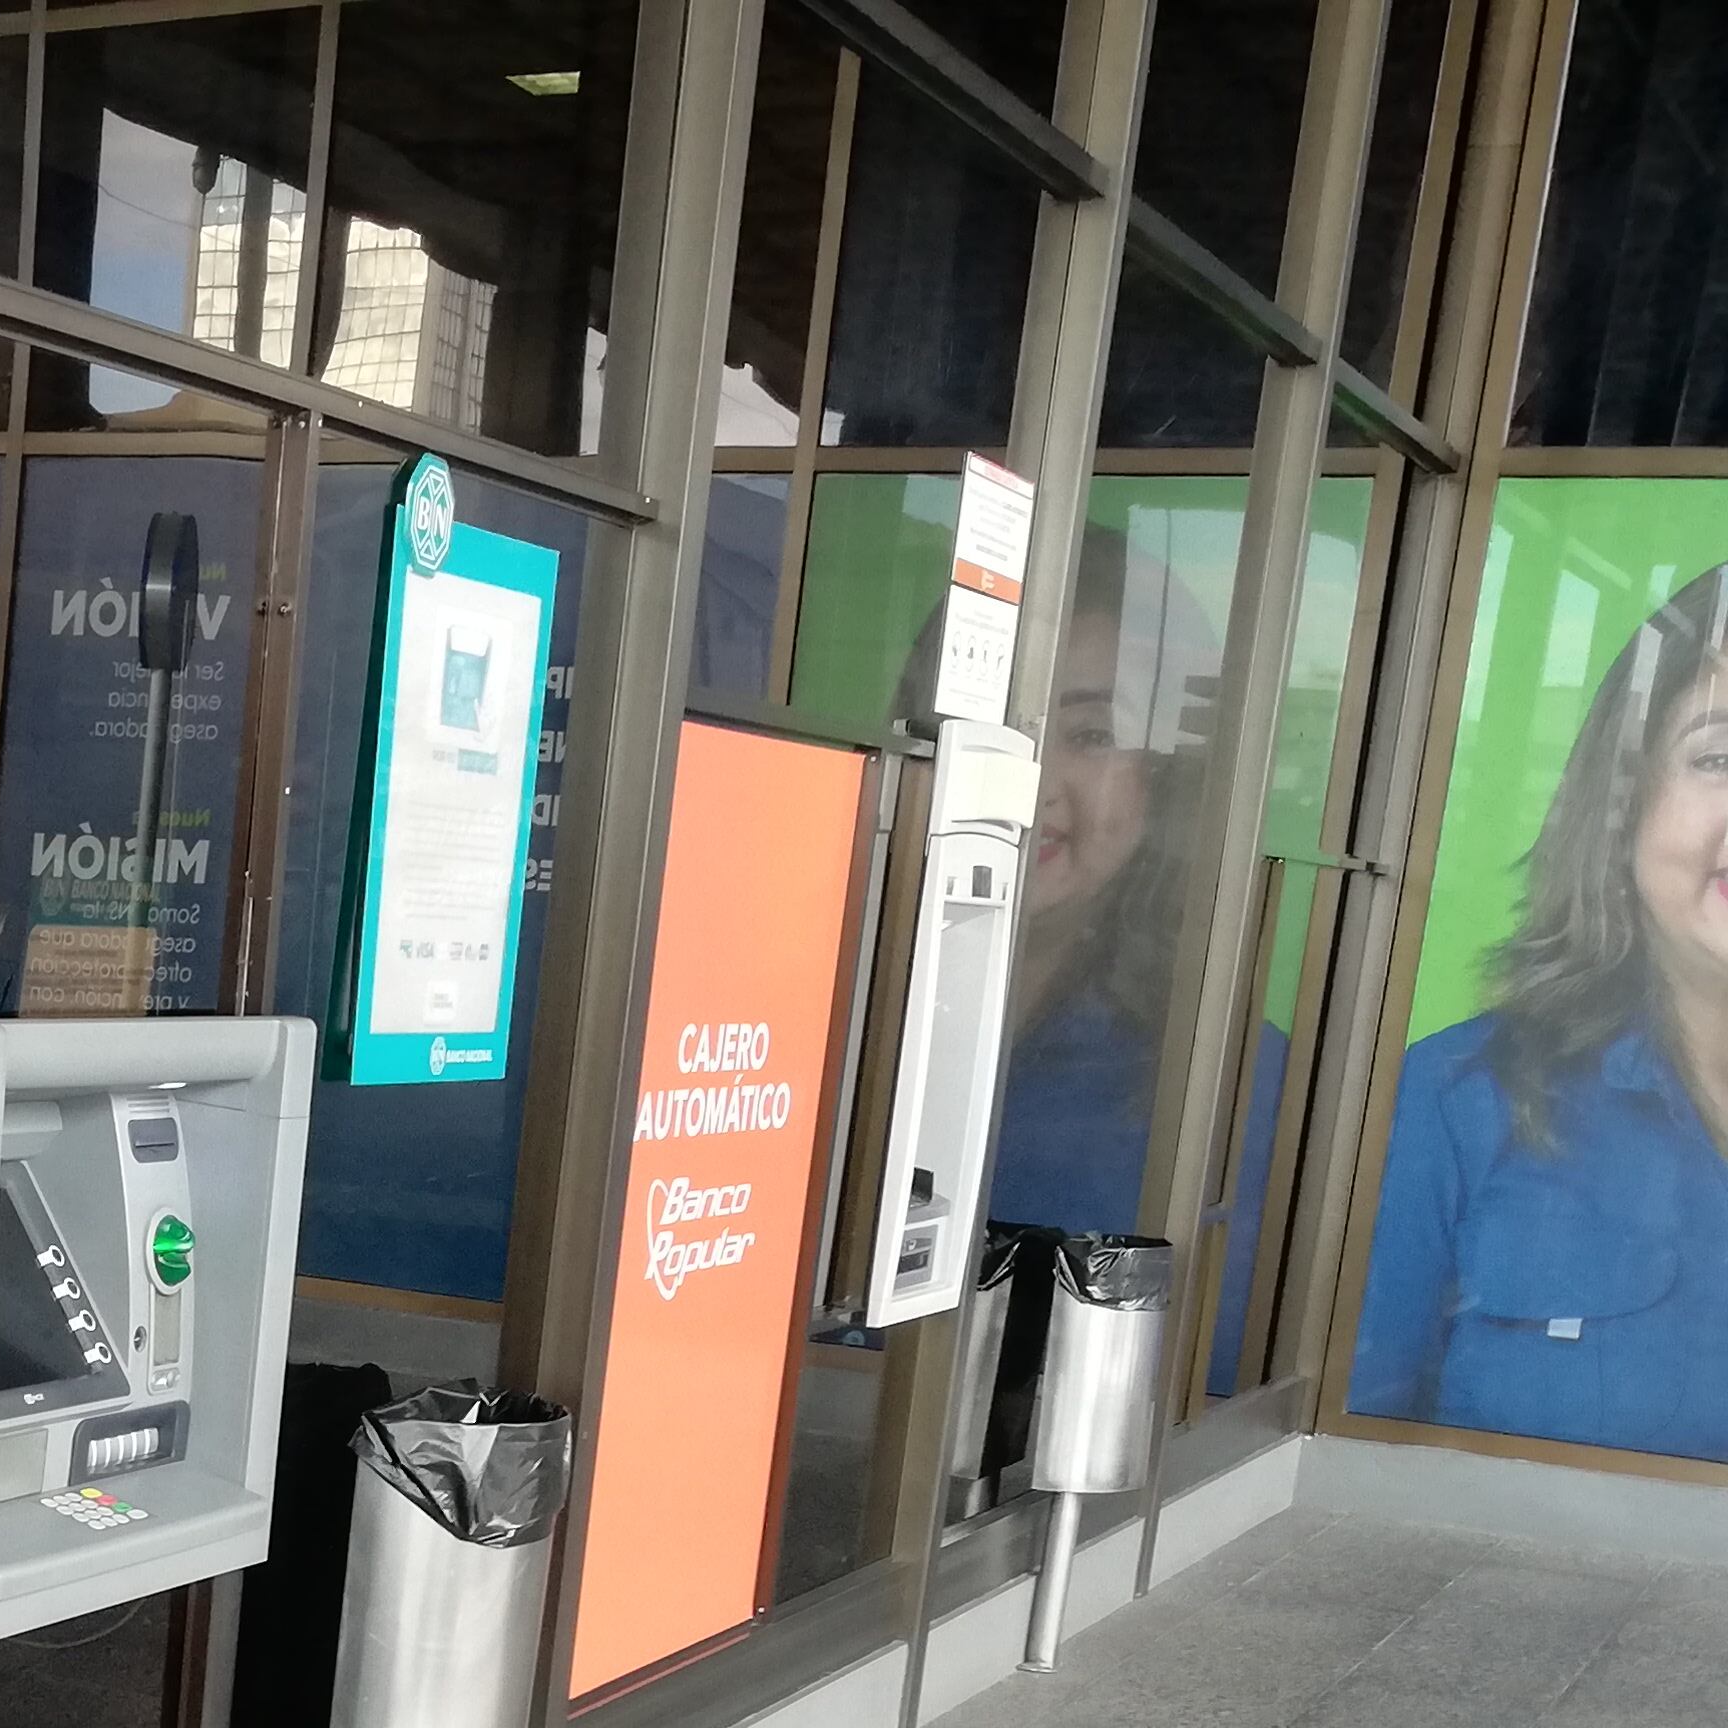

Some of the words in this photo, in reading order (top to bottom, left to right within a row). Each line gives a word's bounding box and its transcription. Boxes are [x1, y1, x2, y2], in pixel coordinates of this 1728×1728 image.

[677, 1021, 770, 1074] CAJERO
[633, 1073, 791, 1142] AUTOMÁTICO
[659, 1177, 752, 1225] Banco
[644, 1227, 756, 1286] Popular
